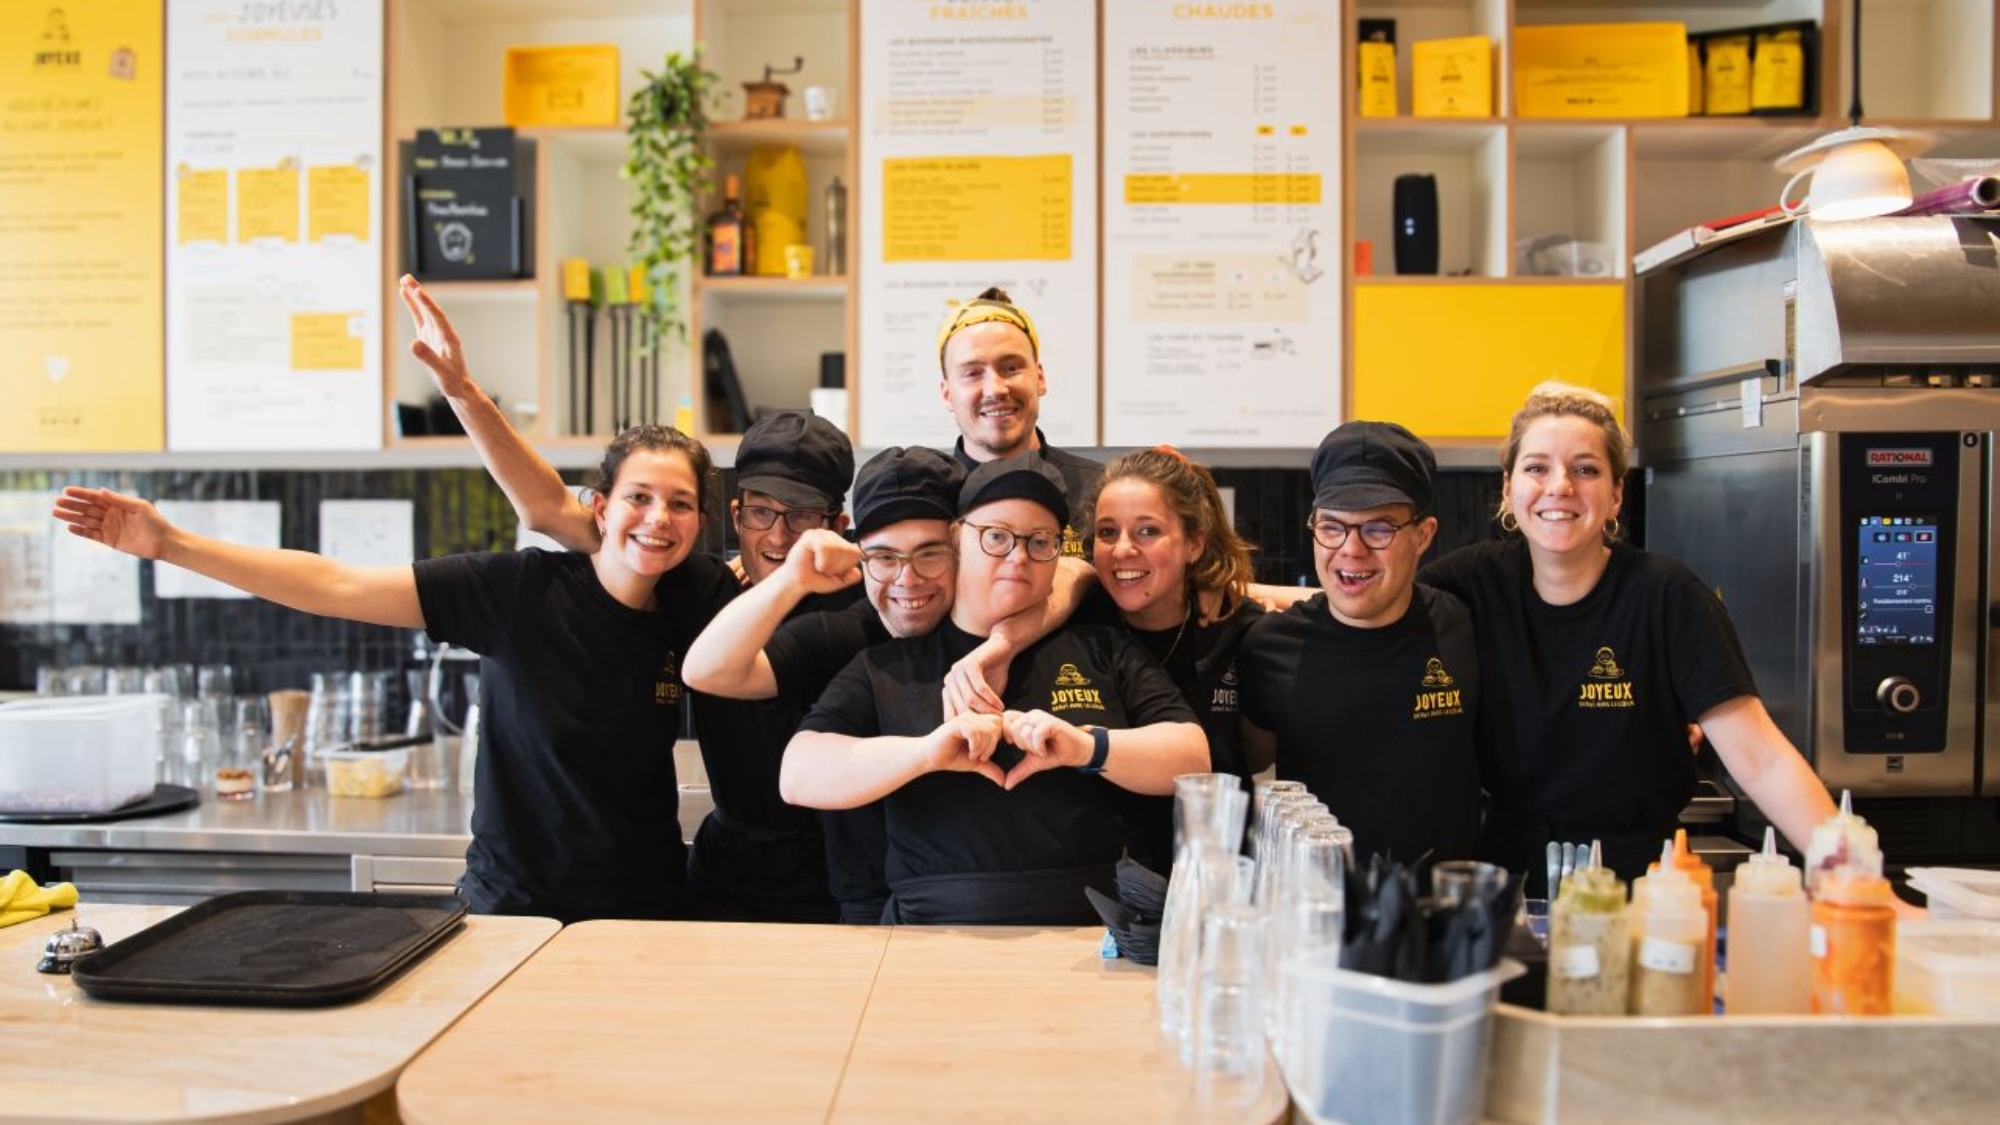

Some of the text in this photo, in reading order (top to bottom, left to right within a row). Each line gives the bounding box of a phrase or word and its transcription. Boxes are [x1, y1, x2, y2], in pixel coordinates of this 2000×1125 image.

[1172, 4, 1275, 19] CHAUDES
[1870, 452, 1928, 462] RATIONAL
[1910, 473, 1927, 483] Pro
[1051, 688, 1102, 706] JOYEUX
[1579, 682, 1633, 700] JOYEUX
[1414, 688, 1462, 712] JOYEUX
